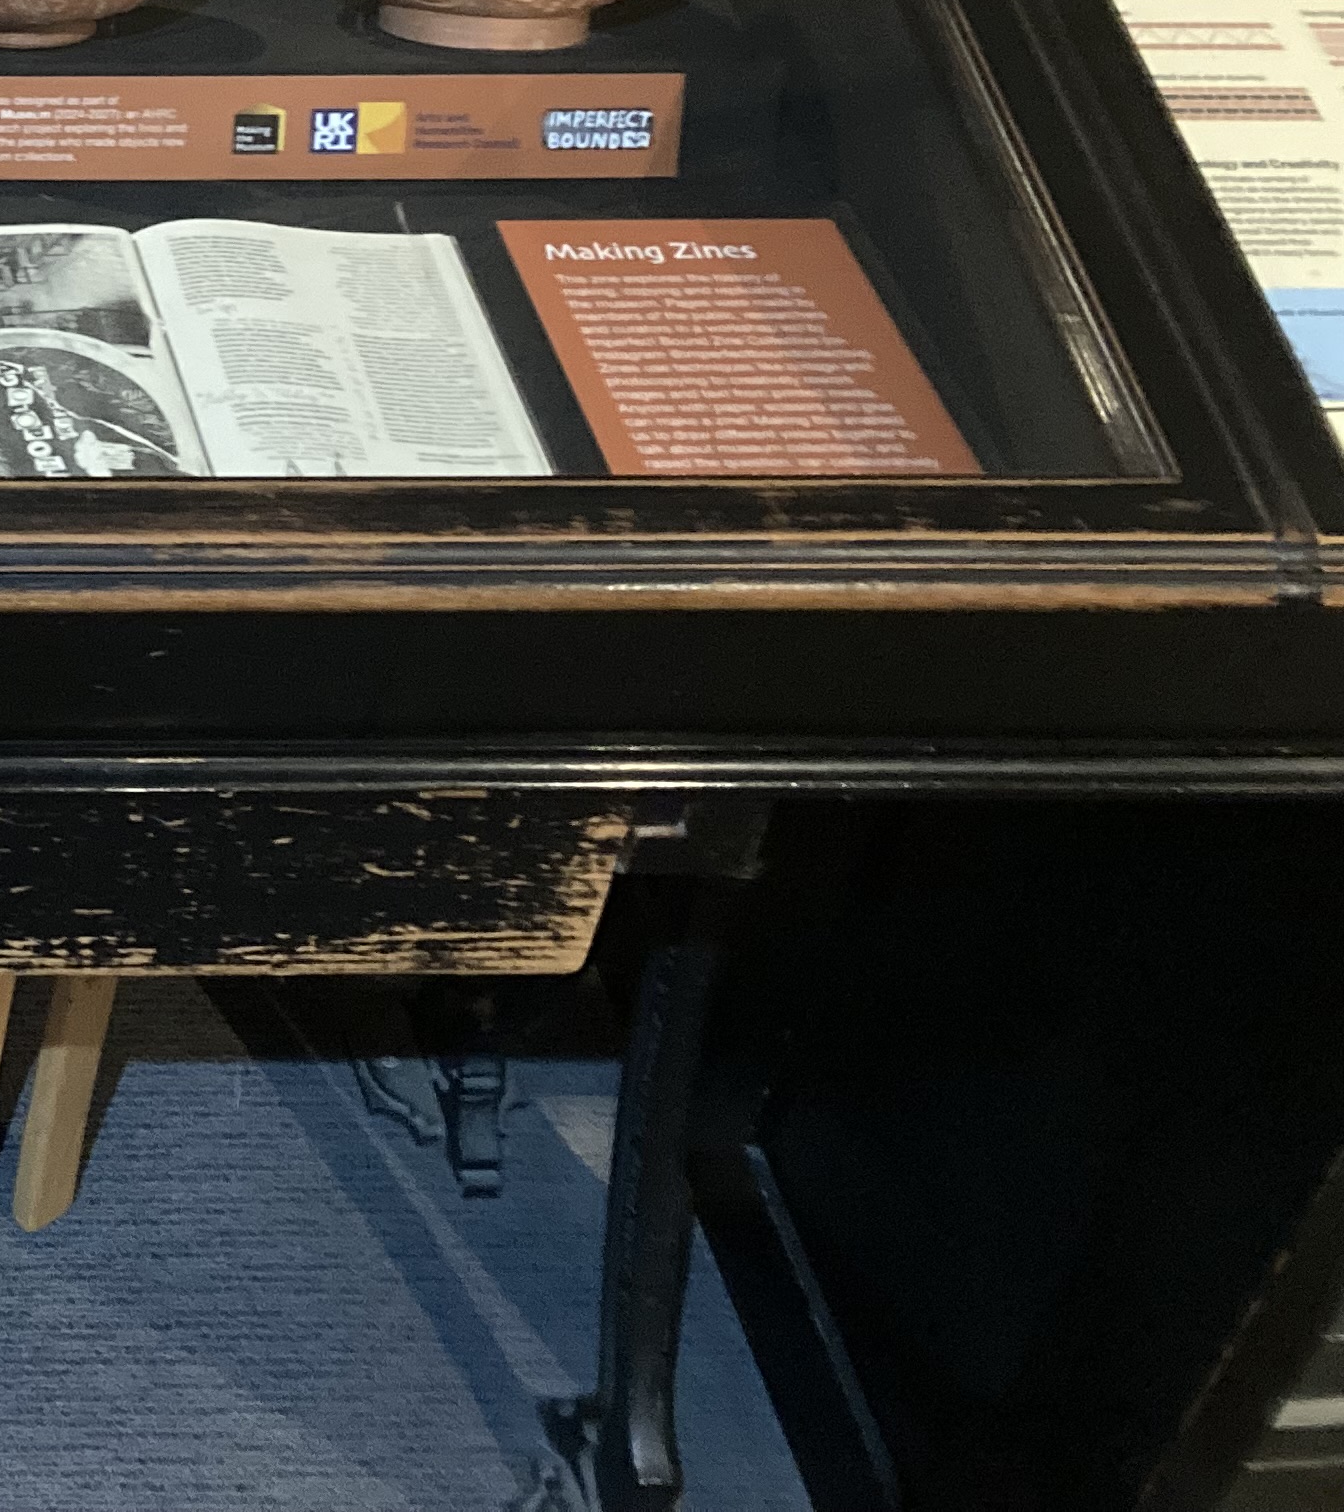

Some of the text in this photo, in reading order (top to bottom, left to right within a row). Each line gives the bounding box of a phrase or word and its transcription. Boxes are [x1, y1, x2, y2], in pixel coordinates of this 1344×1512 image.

[315, 112, 355, 133] UK
[549, 110, 653, 128] IMPERFECT
[313, 131, 353, 150] RI
[545, 242, 756, 263] Making Zines
